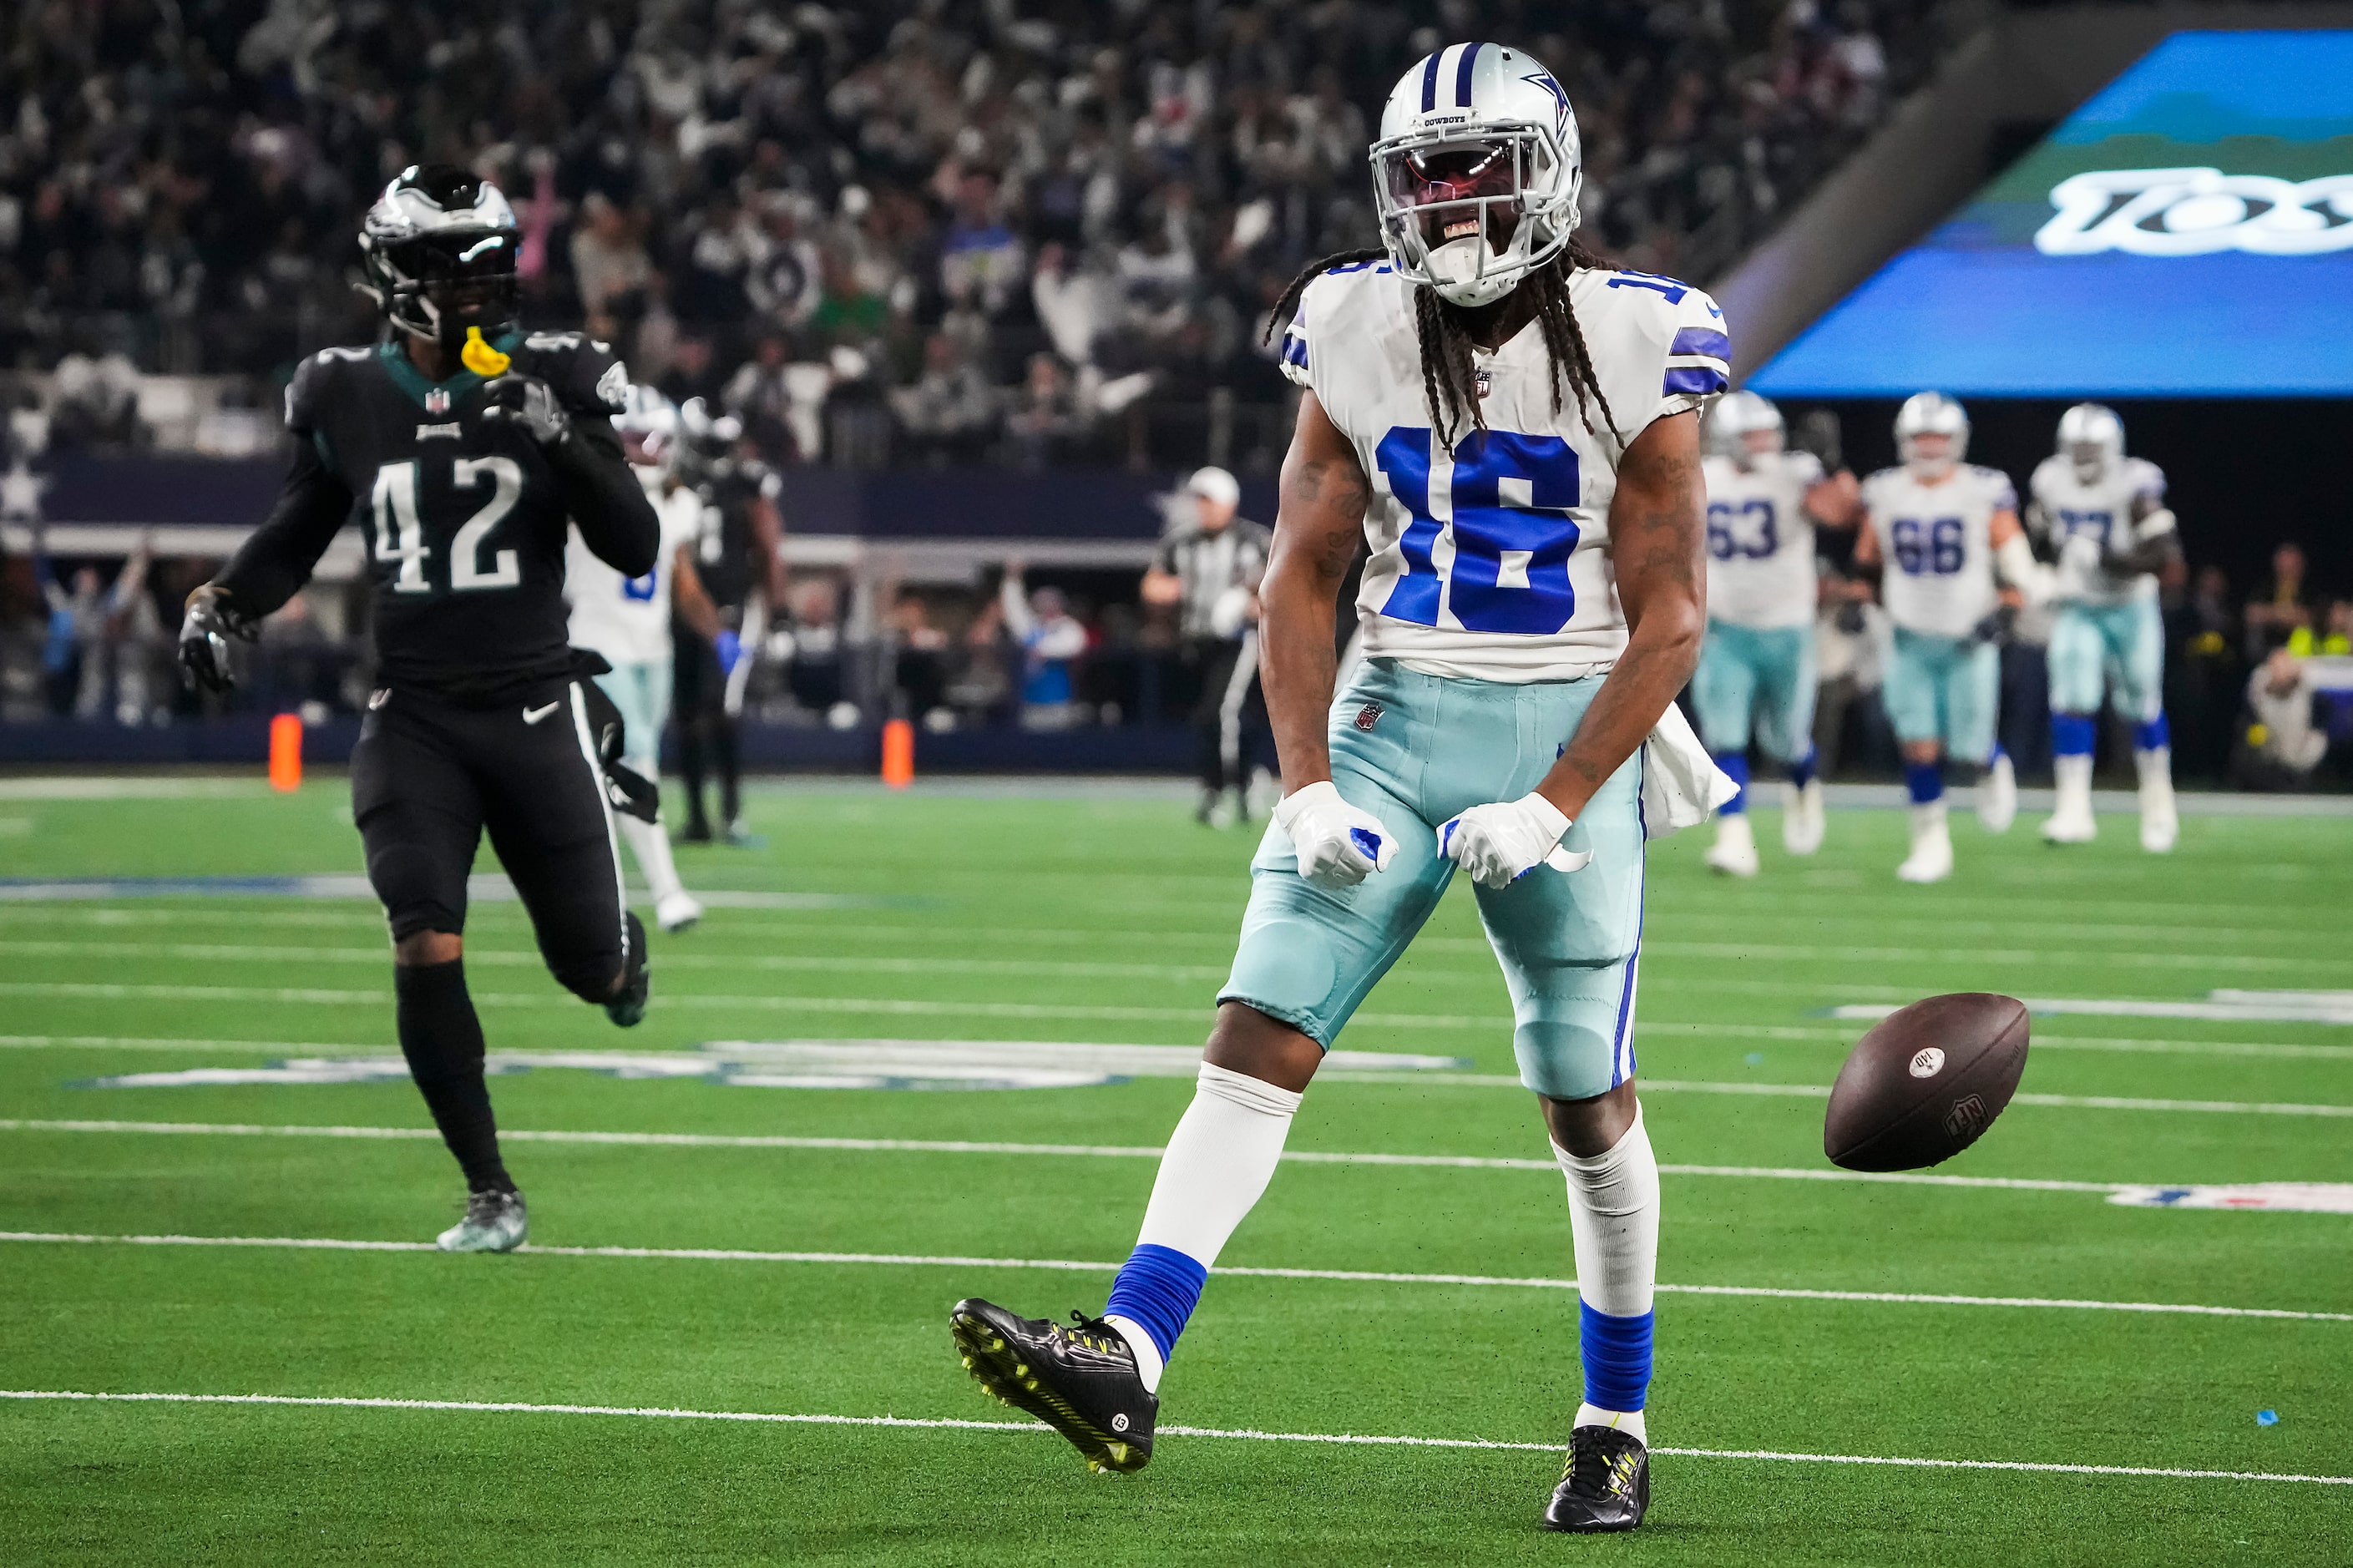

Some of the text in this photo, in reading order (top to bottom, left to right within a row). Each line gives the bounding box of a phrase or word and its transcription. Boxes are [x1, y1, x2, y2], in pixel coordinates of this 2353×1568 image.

[1424, 115, 1466, 127] COWBOYS
[372, 456, 523, 592] 42
[1375, 426, 1581, 635] 16
[1707, 499, 1778, 562] 63
[1891, 517, 1966, 576] 66
[1946, 1099, 1983, 1136] NFL
[1115, 1417, 1126, 1429] 13
